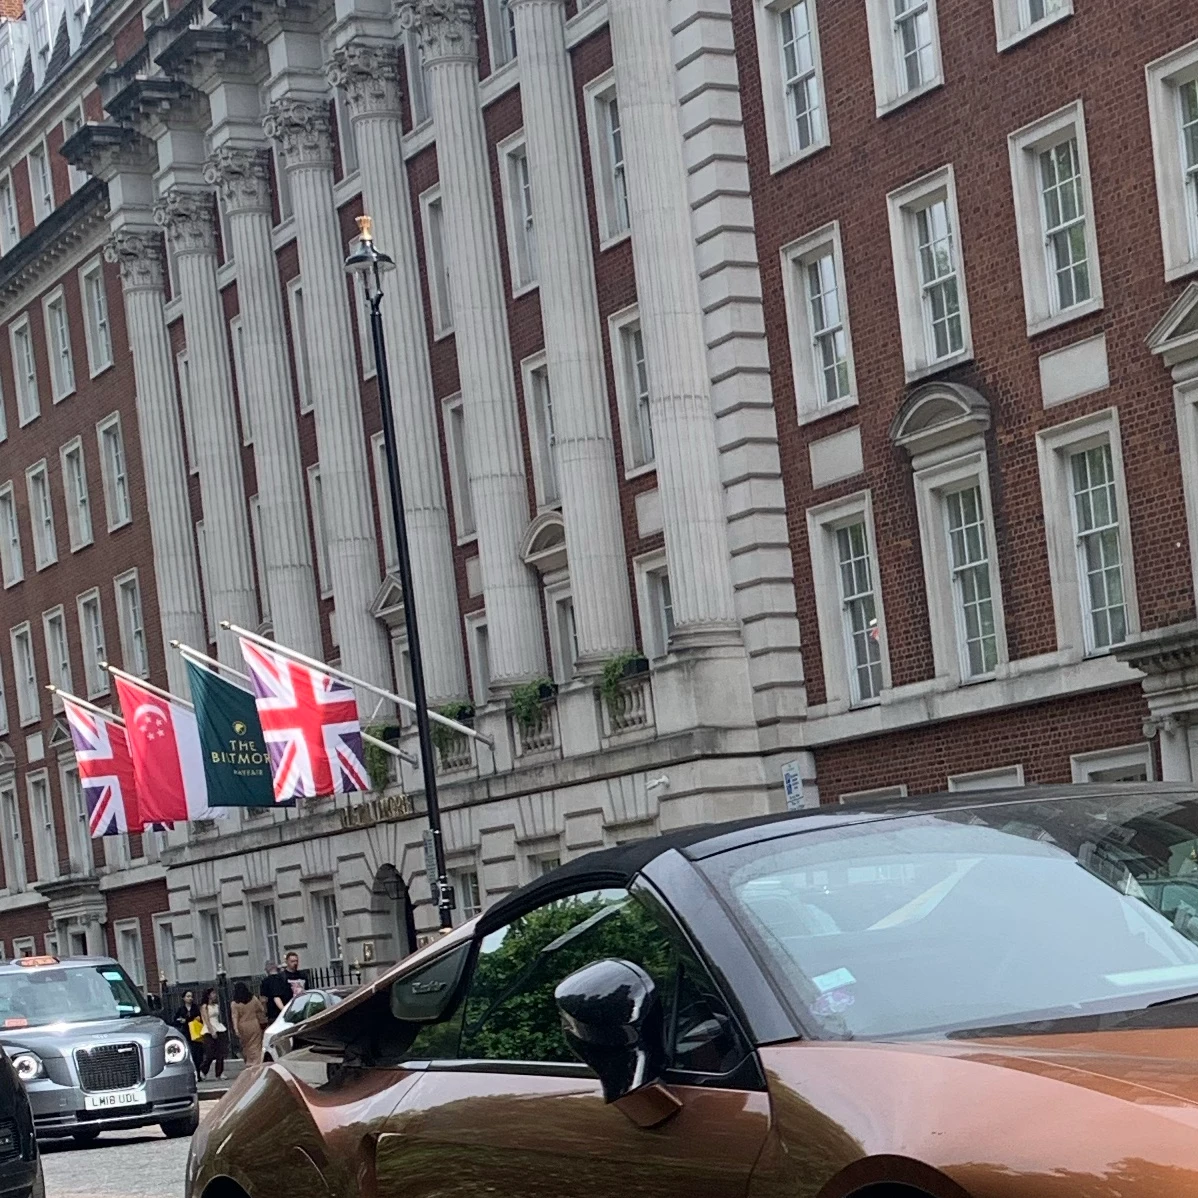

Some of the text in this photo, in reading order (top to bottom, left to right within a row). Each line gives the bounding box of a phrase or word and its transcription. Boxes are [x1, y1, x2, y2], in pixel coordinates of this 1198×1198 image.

[229, 740, 257, 751] THE
[211, 751, 271, 764] BILTMOR
[118, 1093, 139, 1104] UDL
